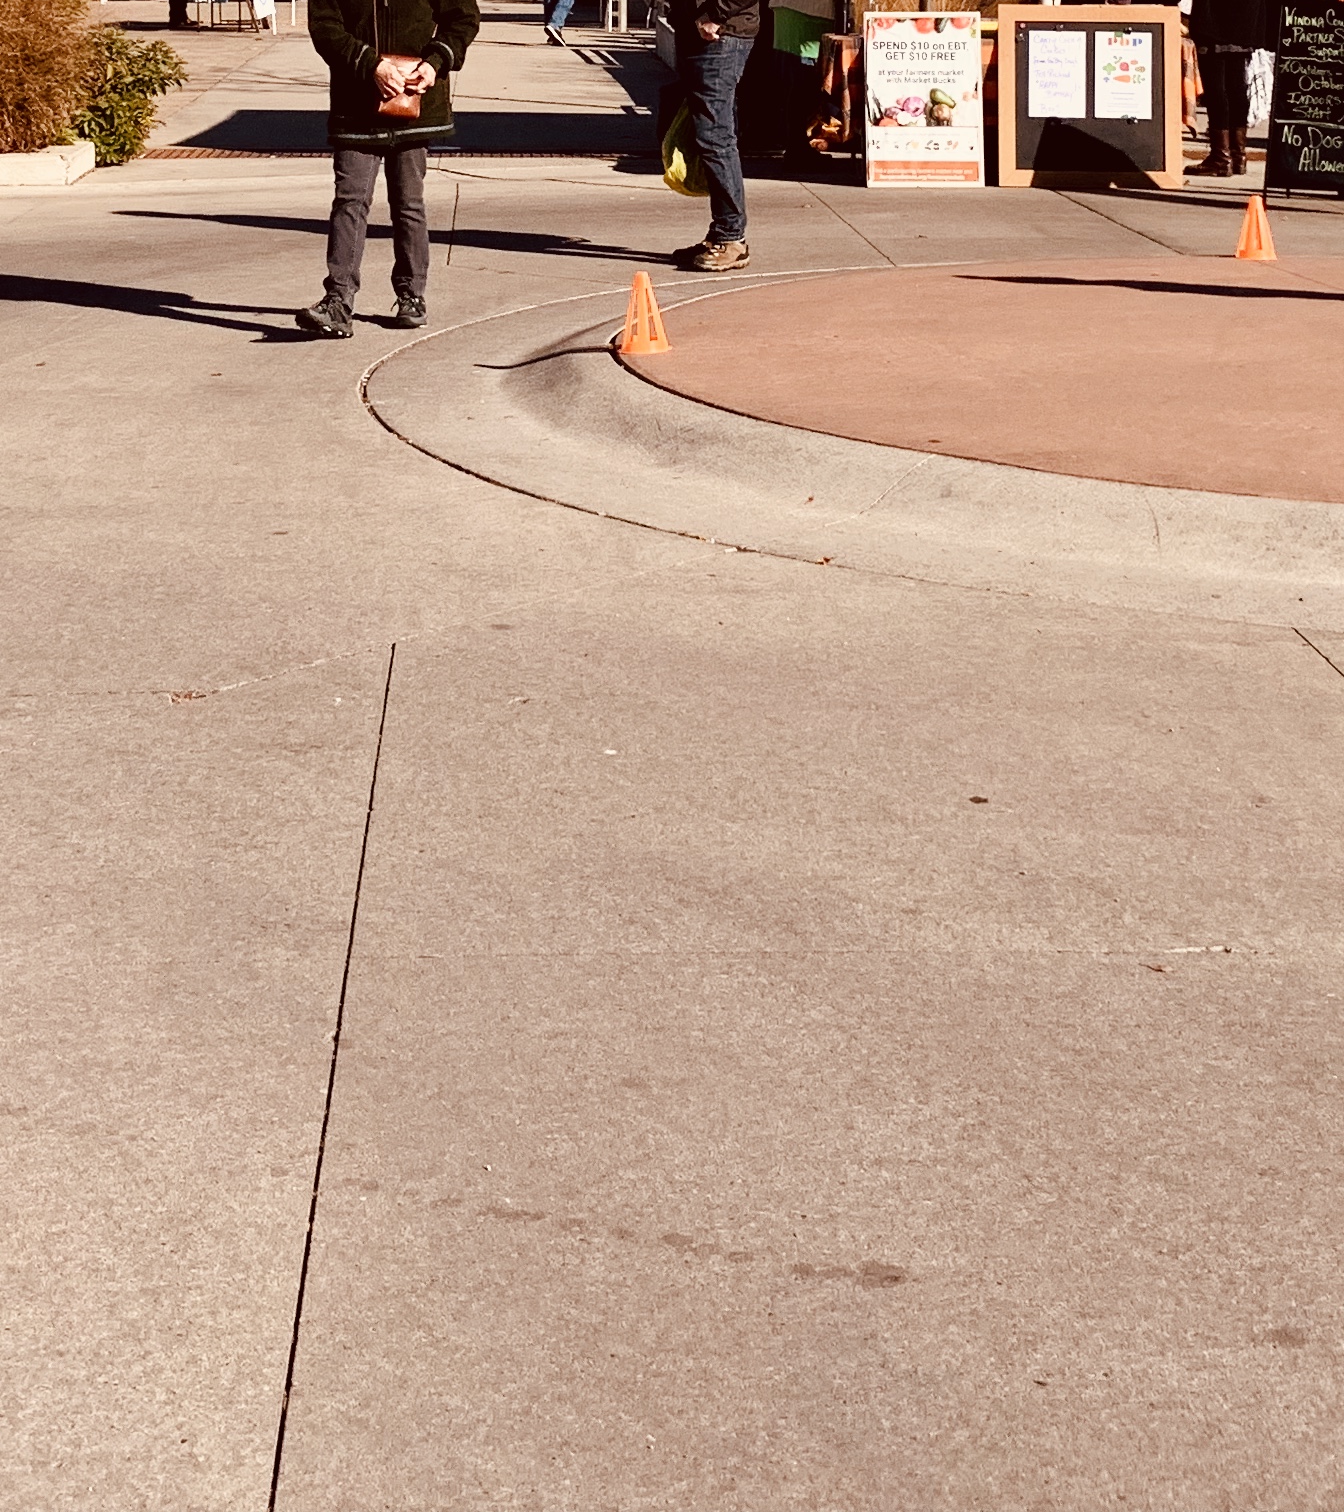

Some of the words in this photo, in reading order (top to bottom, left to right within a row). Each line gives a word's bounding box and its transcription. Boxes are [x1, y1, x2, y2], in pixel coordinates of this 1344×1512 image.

[872, 41, 908, 50] SPEND
[910, 40, 930, 51] $10
[932, 42, 945, 50] on
[885, 51, 906, 61] GET
[908, 51, 928, 61] $10
[930, 51, 956, 61] FREE
[904, 76, 931, 84] Market
